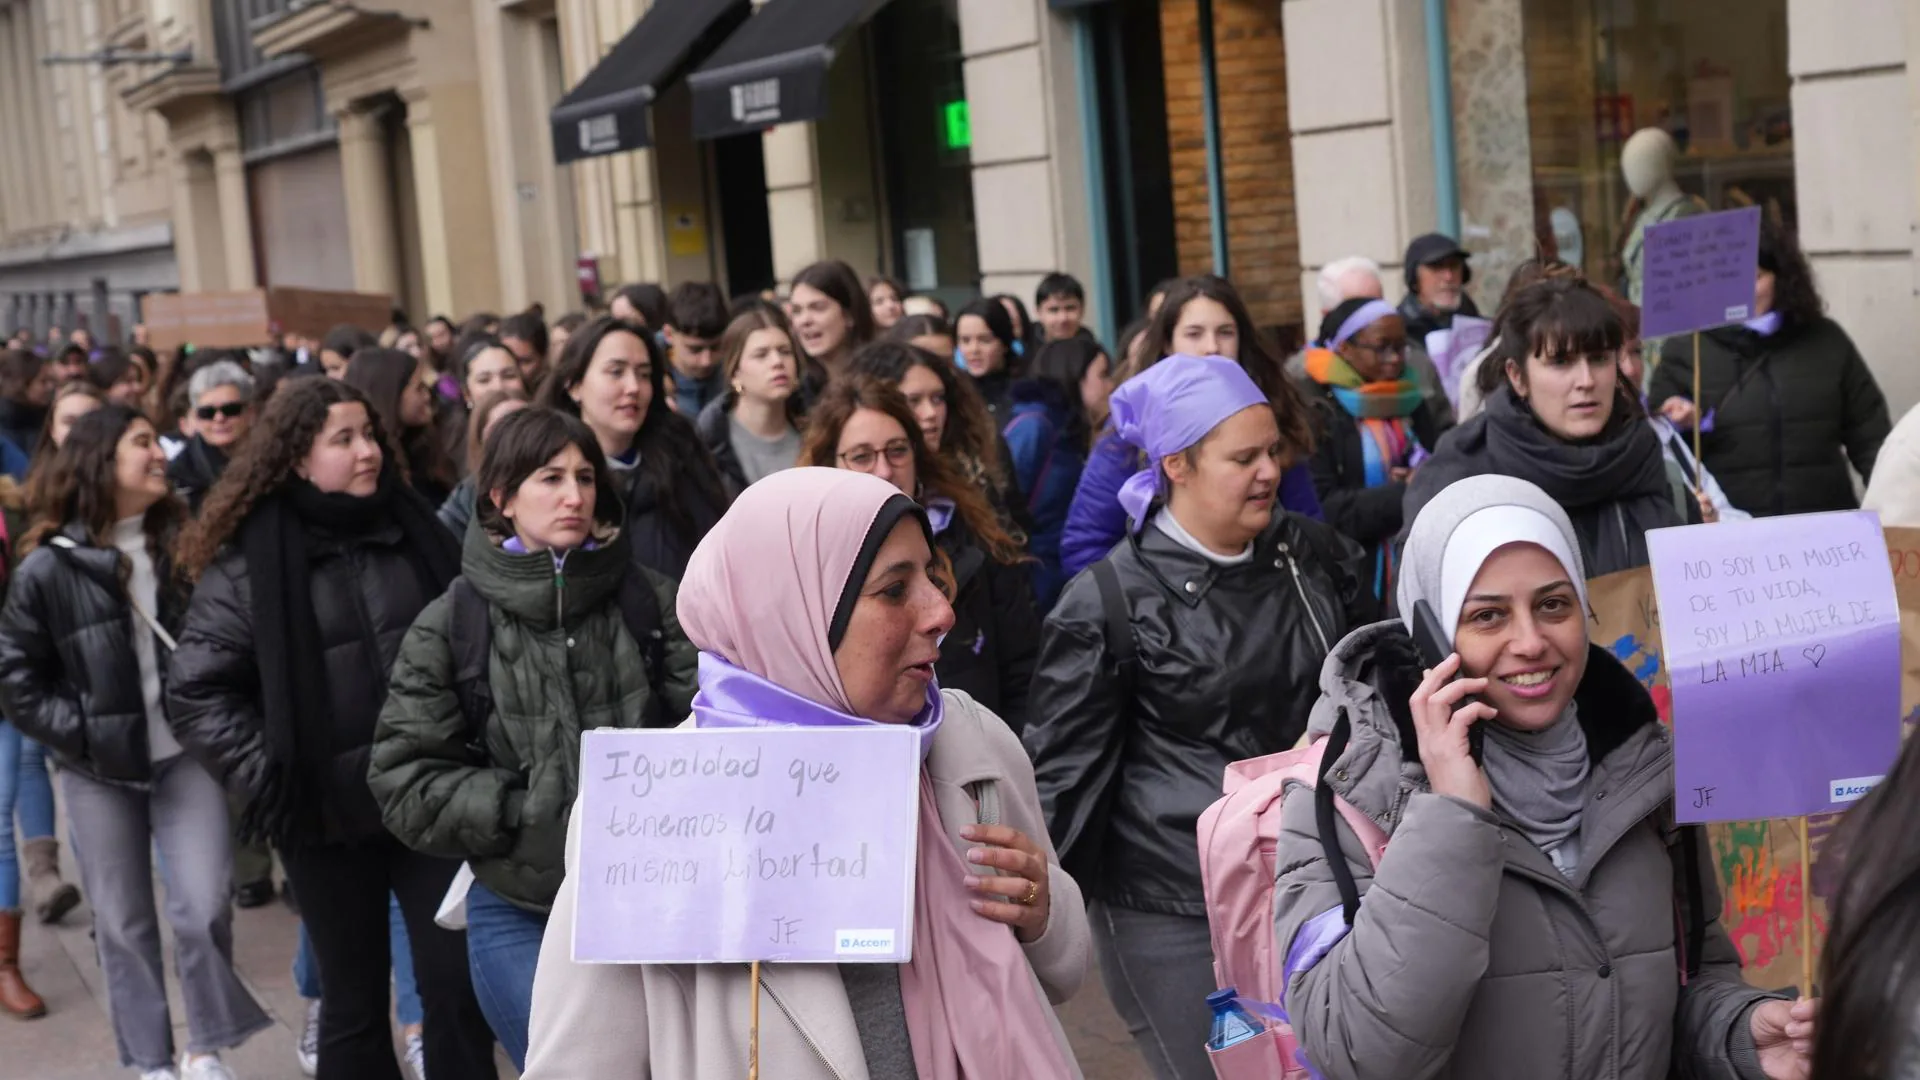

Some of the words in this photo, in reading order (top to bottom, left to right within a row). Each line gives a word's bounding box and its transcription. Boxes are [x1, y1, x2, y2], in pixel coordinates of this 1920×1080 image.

[1683, 559, 1711, 581] NO
[1722, 556, 1756, 577] SOY
[1765, 553, 1792, 572] LA
[1803, 541, 1868, 568] MUJER
[1689, 595, 1717, 613] DE
[1728, 588, 1755, 607] TU
[1694, 625, 1728, 649] SOY
[1742, 619, 1769, 643] LA
[1775, 604, 1843, 636] MUJER
[1849, 600, 1876, 625] DE
[1701, 659, 1728, 684] LA
[602, 746, 761, 798] Igualdad
[788, 758, 840, 797] que
[1693, 786, 1717, 809] JF
[605, 806, 728, 838] tenemos
[744, 806, 776, 834] la
[605, 857, 699, 885] misma
[724, 842, 868, 881] Libertad
